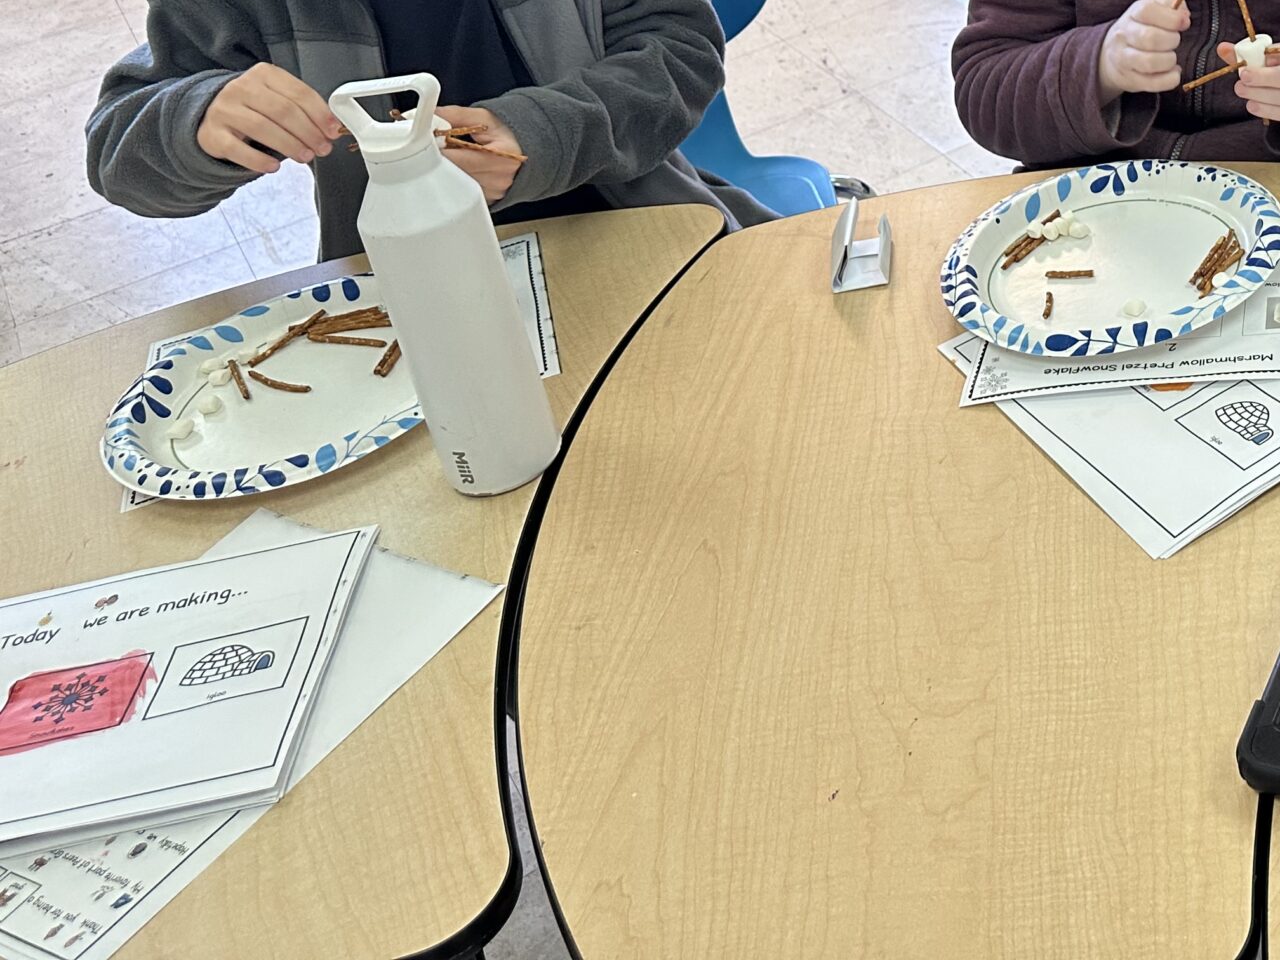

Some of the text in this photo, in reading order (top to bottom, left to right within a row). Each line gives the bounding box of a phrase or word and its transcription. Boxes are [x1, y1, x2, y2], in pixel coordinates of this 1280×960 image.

[1043, 353, 1273, 376] Marshmallow Pretzel Snowflake
[452, 451, 475, 484] MiiR
[1, 589, 248, 649] Today we are making...
[86, 864, 110, 878] part
[63, 912, 82, 923] you
[80, 918, 103, 935] Thank
